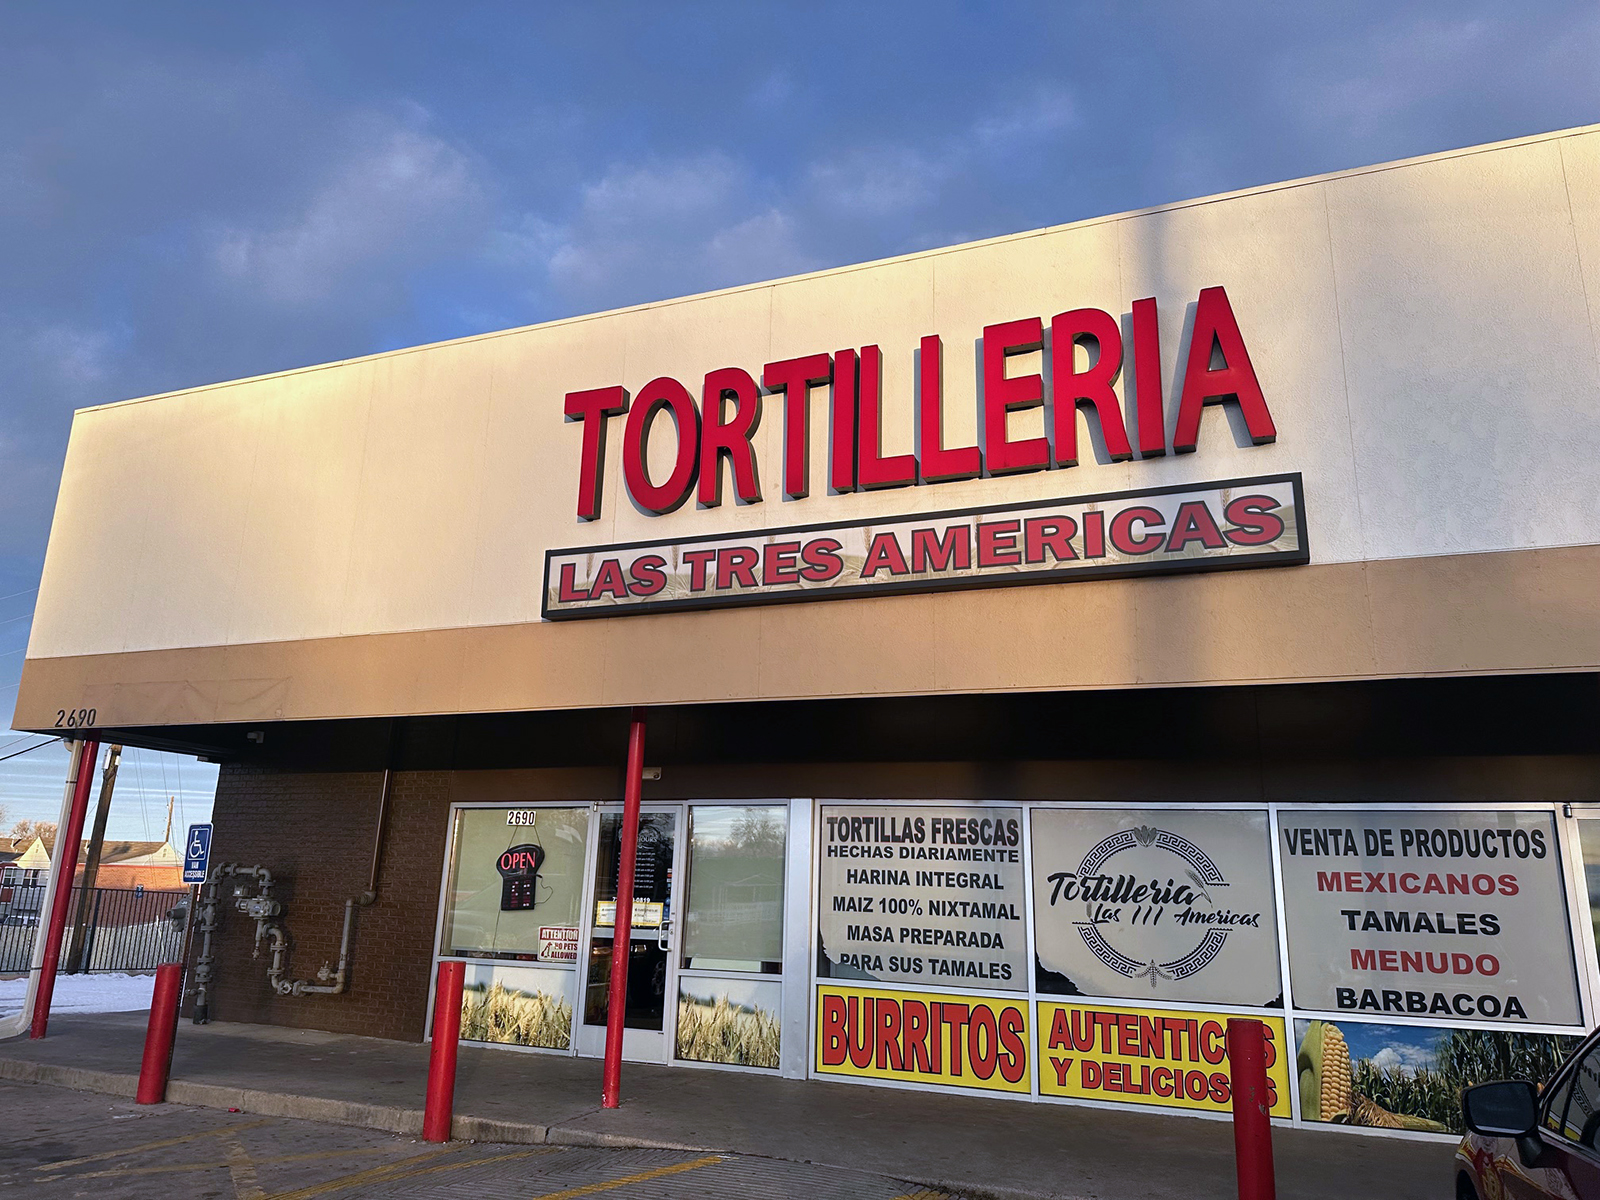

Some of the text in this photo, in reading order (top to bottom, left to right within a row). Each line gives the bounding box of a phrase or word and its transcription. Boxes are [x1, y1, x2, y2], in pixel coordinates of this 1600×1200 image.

[564, 285, 1277, 521] TORTILLERIA
[558, 493, 1285, 602] LAS TRES AMERICAS
[55, 708, 97, 727] 2690
[508, 811, 535, 825] 2690
[826, 816, 1019, 846] TORTILLAS FRESCAS
[1284, 828, 1547, 859] VENTA DE PRODUCTOS
[500, 852, 536, 870] OPEN
[827, 845, 1019, 863] HECHAS DIARIAMENTE
[846, 869, 1004, 890] HARINA INTEGRAL
[1047, 872, 1205, 906] Tortilleria
[1316, 871, 1520, 897] MEXICANOS
[832, 896, 1021, 920] MAIZ 100% NIXTAMAL
[1090, 903, 1122, 925] Las
[1174, 908, 1261, 928] Americas
[541, 929, 578, 940] ATTENTION
[1341, 910, 1501, 935] TAMALES
[554, 942, 578, 951] NO PETS
[847, 925, 1005, 949] MASA PREPARADA
[551, 951, 578, 960] ALLOWED
[840, 953, 1013, 981] PARA SUS TAMALES
[1350, 949, 1500, 976] MENUDO
[1335, 987, 1528, 1019] BARBACOA
[822, 994, 1026, 1084] BURRITOS
[1048, 1008, 1277, 1069] AUTENTIC
[1052, 1056, 1278, 1108] Y DELICIOS
